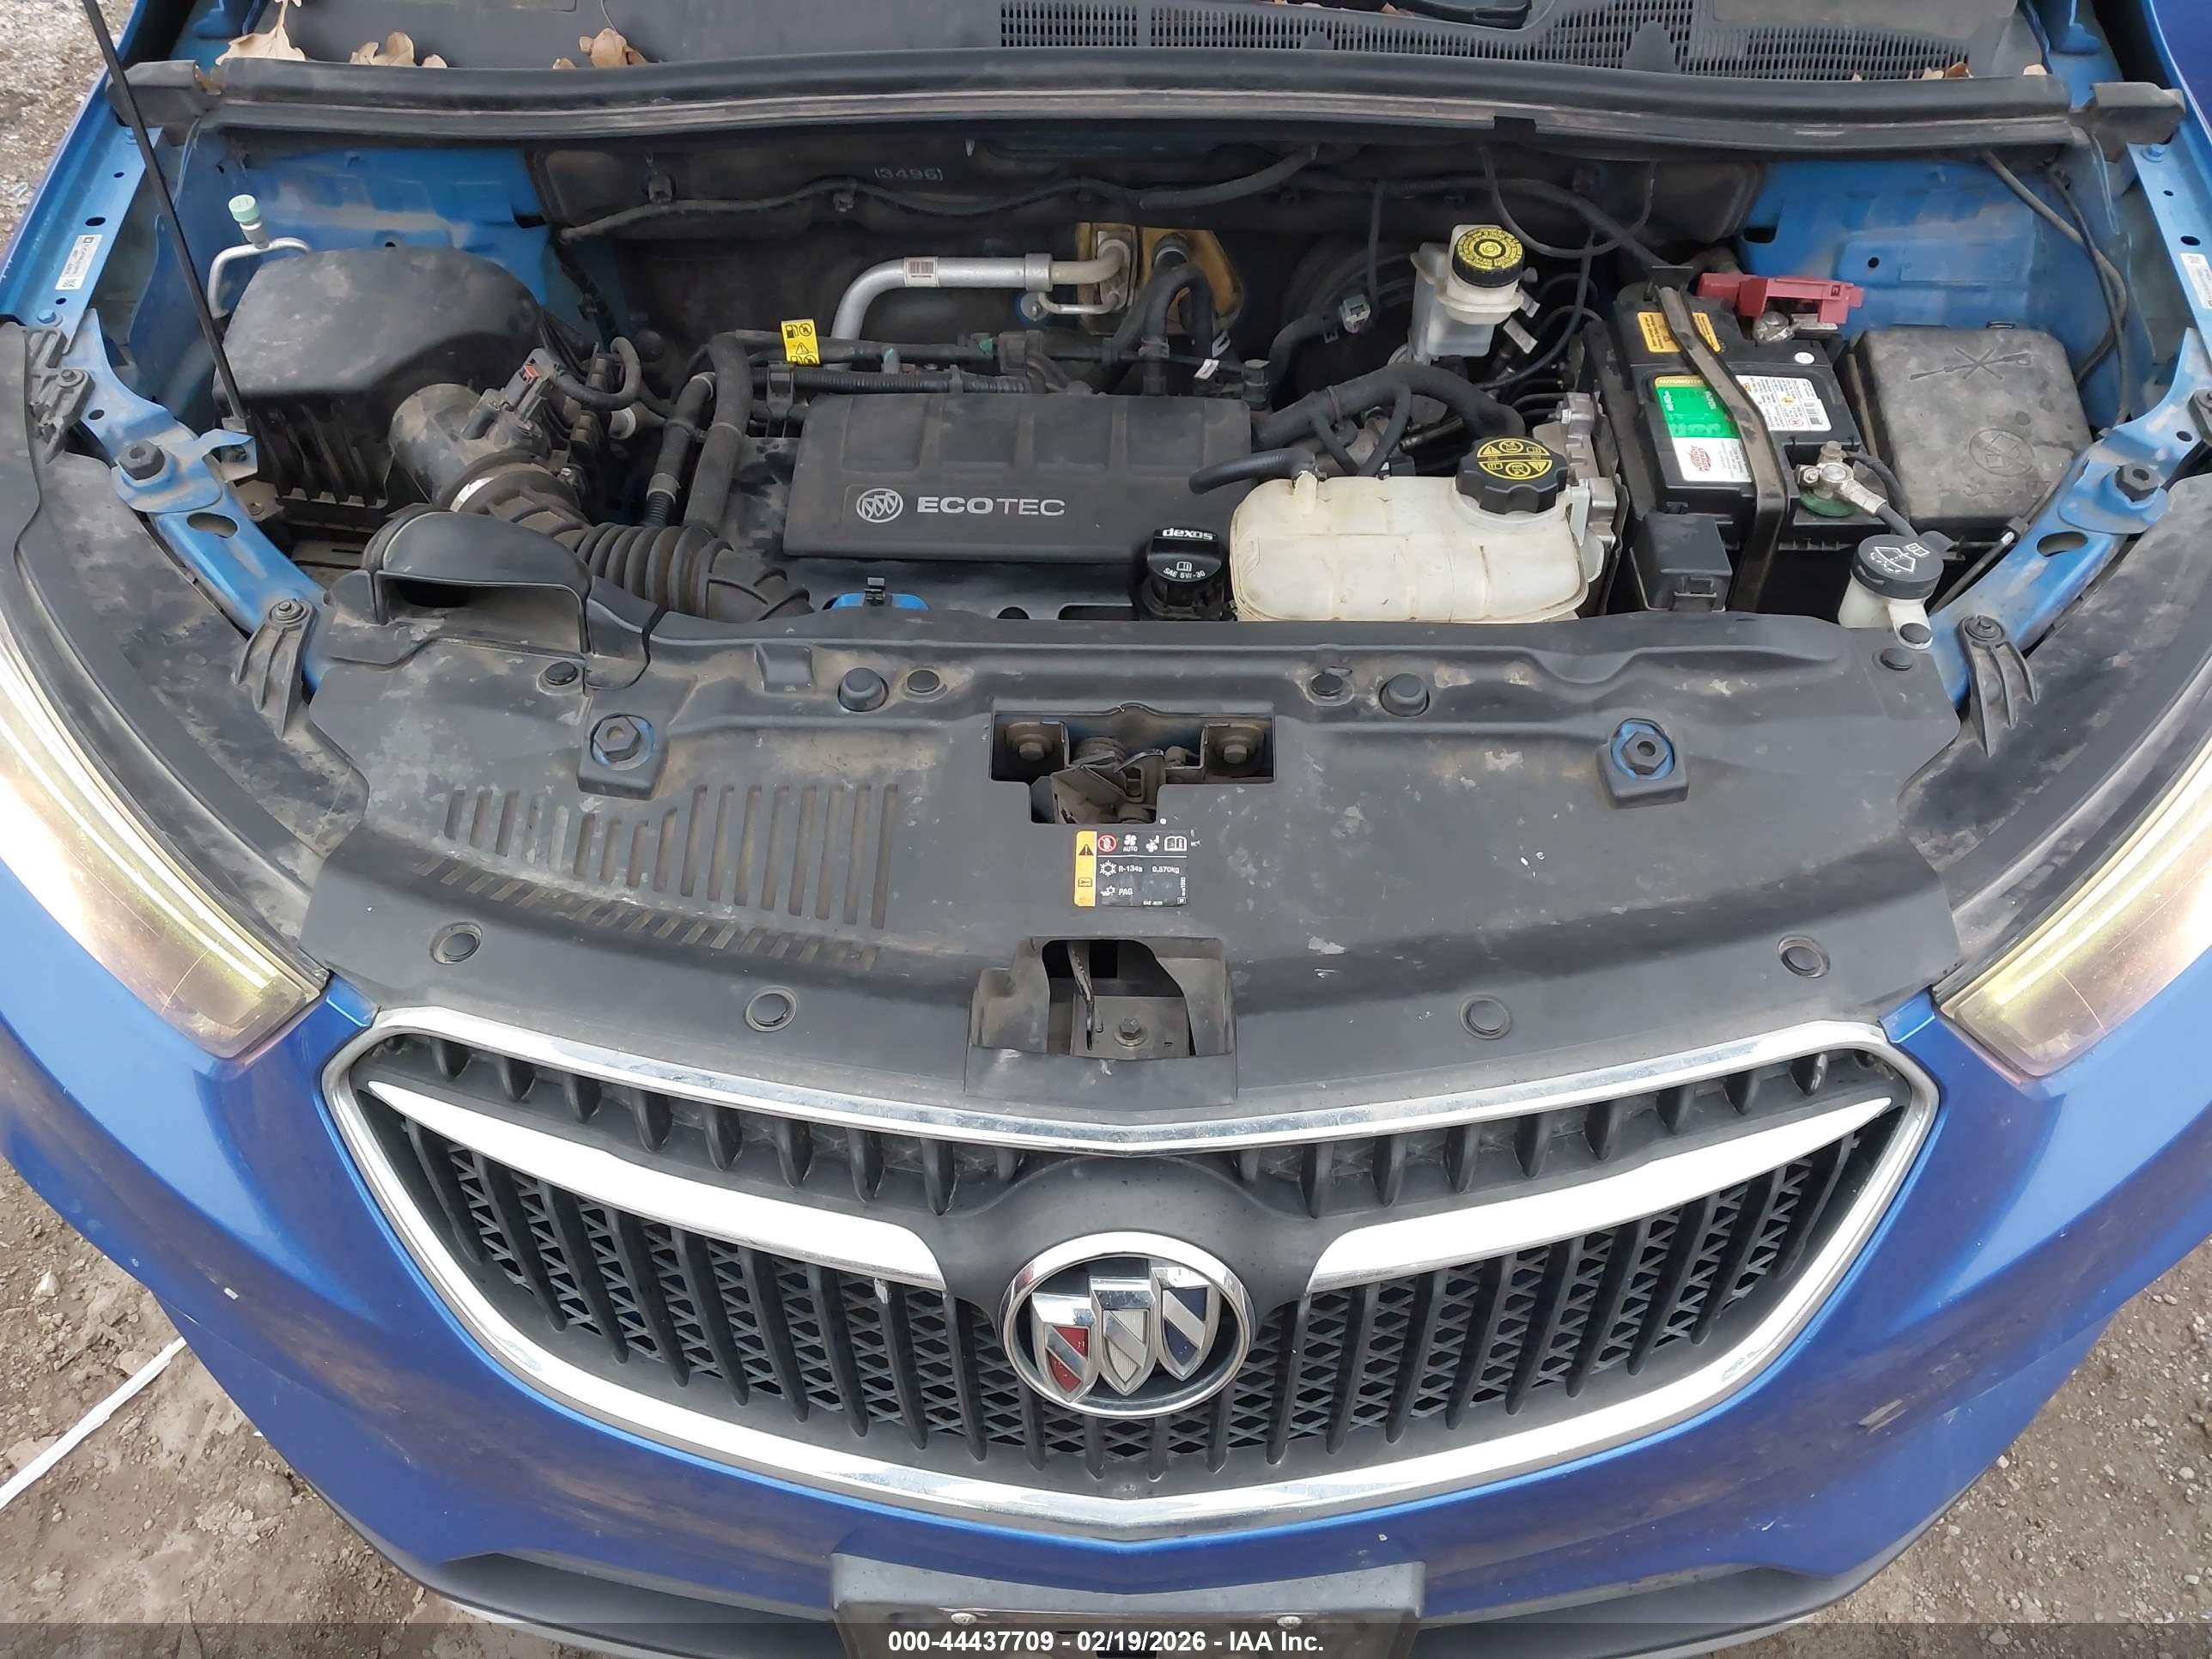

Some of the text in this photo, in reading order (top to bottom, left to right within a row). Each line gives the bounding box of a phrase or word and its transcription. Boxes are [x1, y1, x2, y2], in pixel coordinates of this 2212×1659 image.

[917, 496, 1066, 516] ECOTEC
[1162, 527, 1213, 541] dexos
[1163, 567, 1178, 579] SAE
[1118, 865, 1180, 874] R-134a 0.570kg
